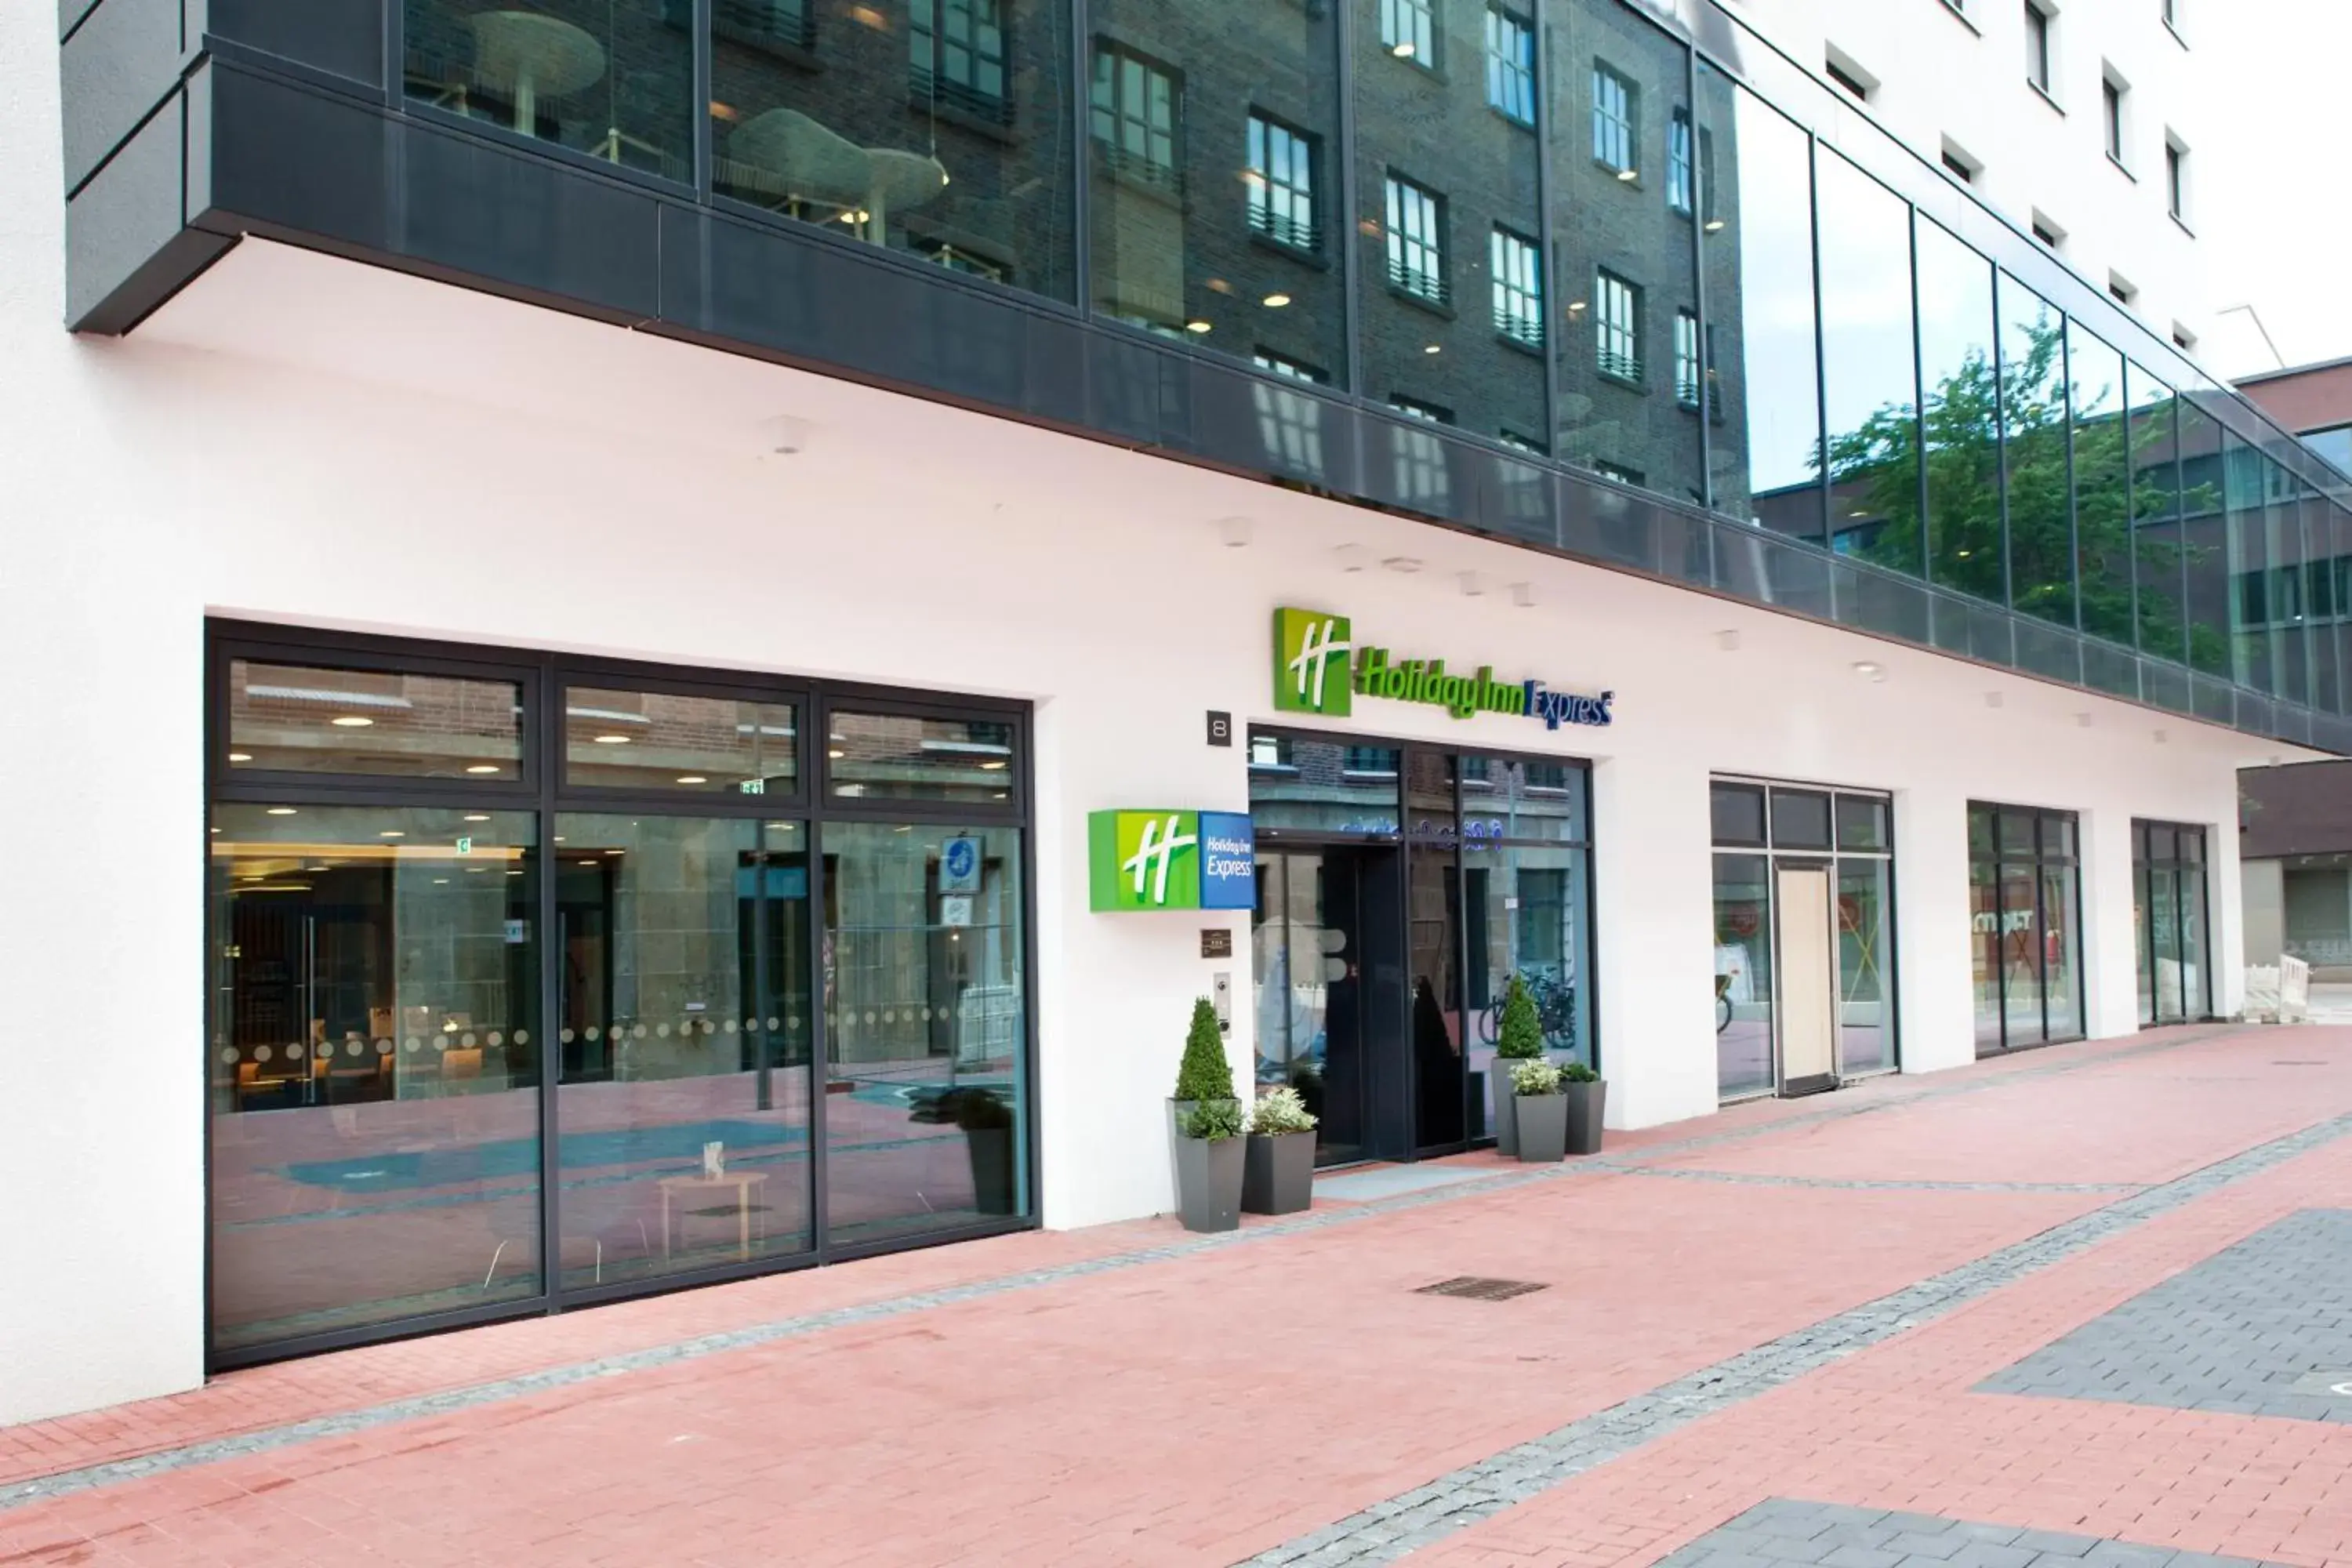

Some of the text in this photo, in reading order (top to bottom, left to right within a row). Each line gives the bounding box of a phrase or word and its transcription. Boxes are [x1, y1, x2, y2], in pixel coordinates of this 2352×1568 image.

[1356, 647, 1613, 731] Holiday Inn Express
[1213, 720, 1228, 737] 8
[1207, 855, 1251, 881] Express
